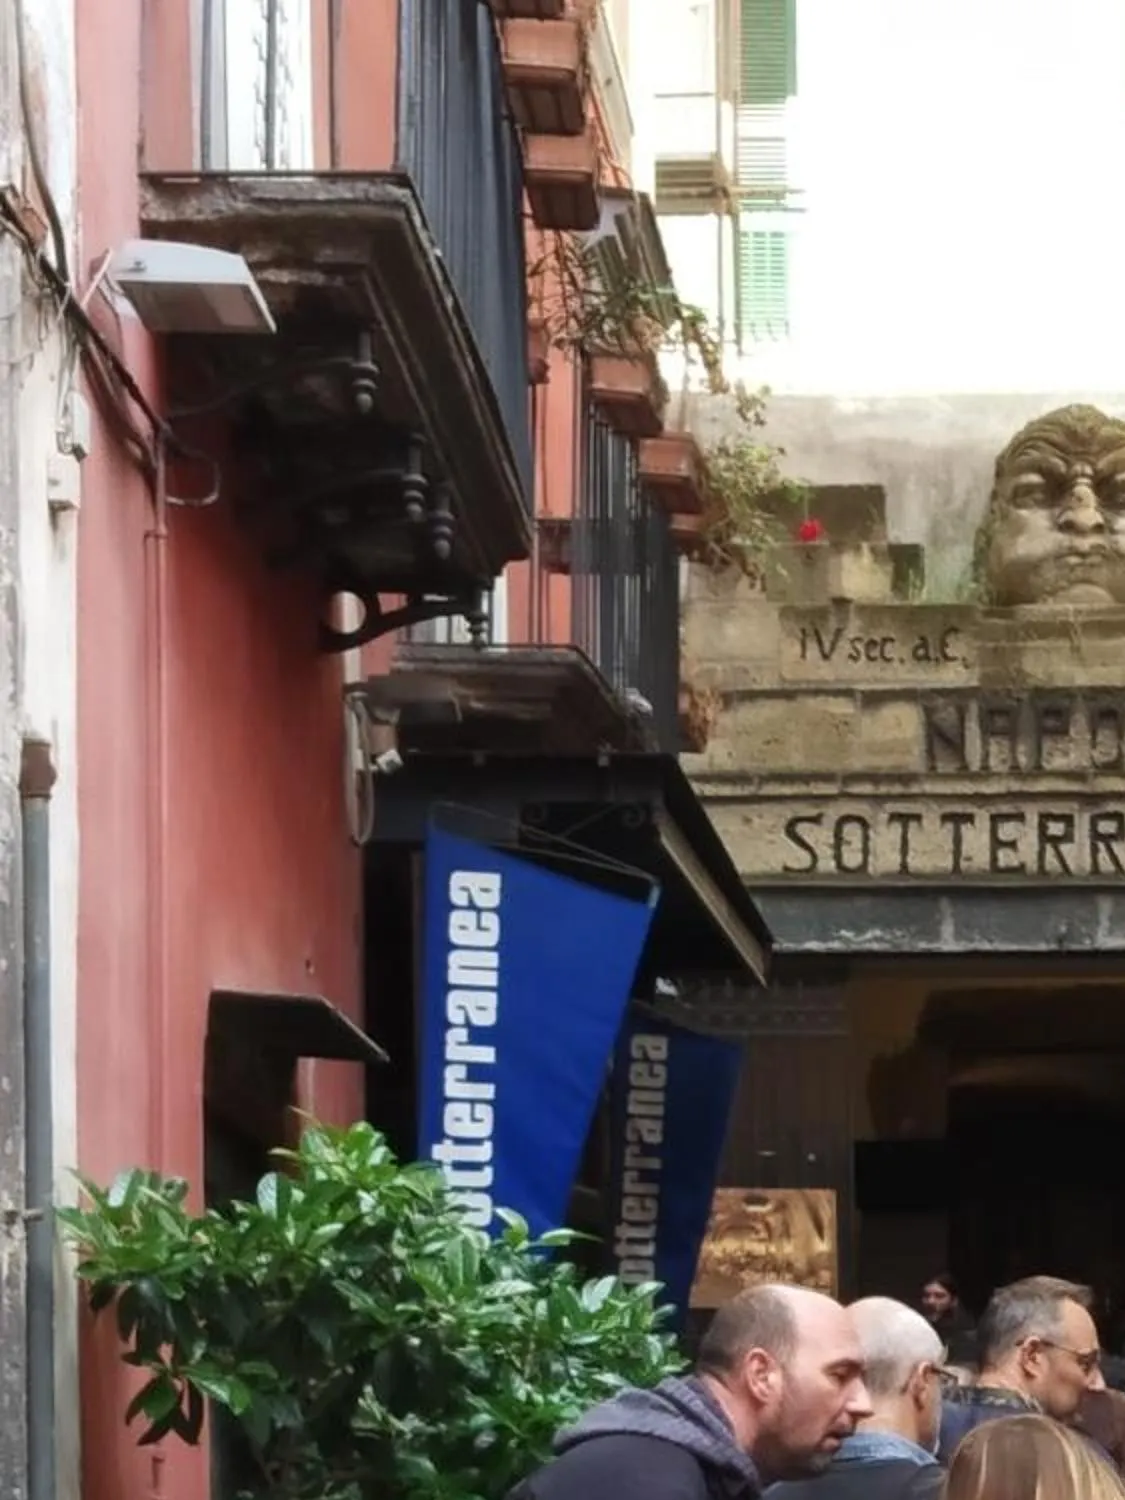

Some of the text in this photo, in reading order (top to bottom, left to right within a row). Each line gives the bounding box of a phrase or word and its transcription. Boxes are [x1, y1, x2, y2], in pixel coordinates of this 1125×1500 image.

[800, 627, 846, 661] IV
[432, 870, 501, 1250] otterranea
[614, 1033, 669, 1285] otterranea
